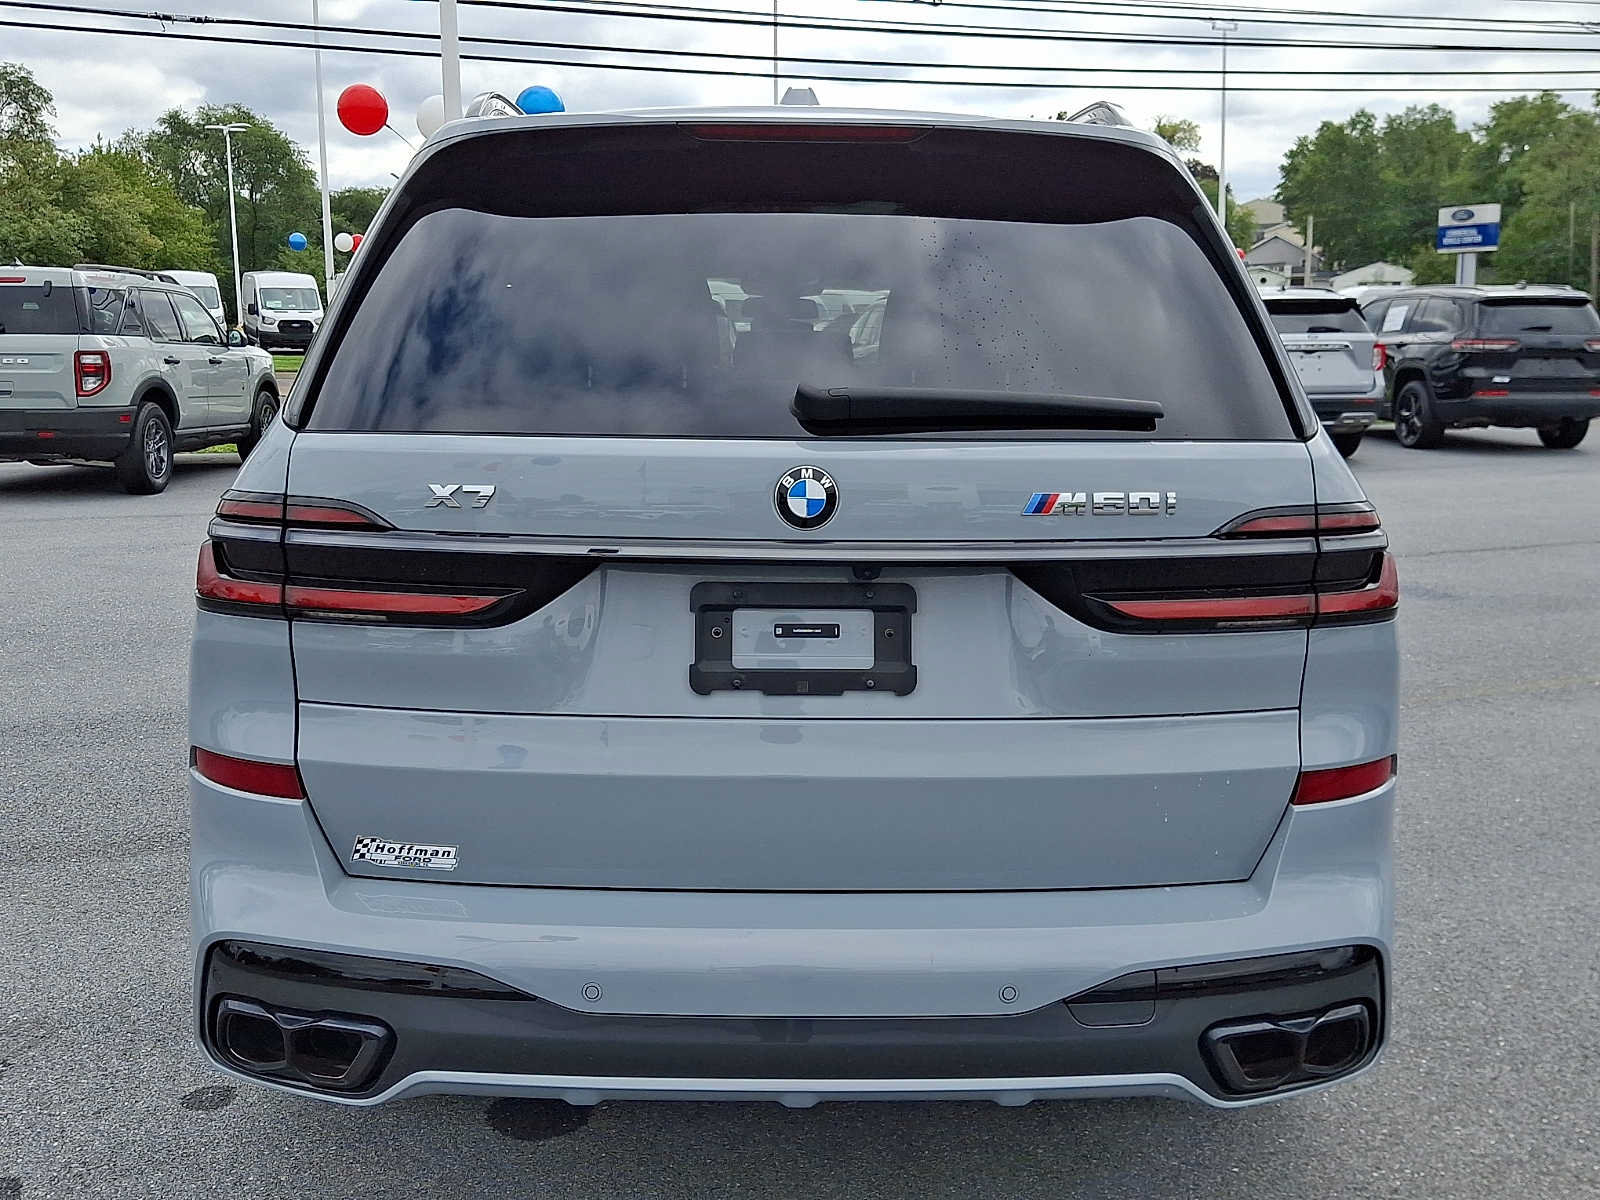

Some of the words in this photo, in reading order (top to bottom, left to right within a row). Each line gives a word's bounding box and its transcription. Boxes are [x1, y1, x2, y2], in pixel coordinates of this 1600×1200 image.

[782, 468, 833, 488] BMW
[424, 484, 496, 508] X7
[374, 843, 452, 858] Hoffman
